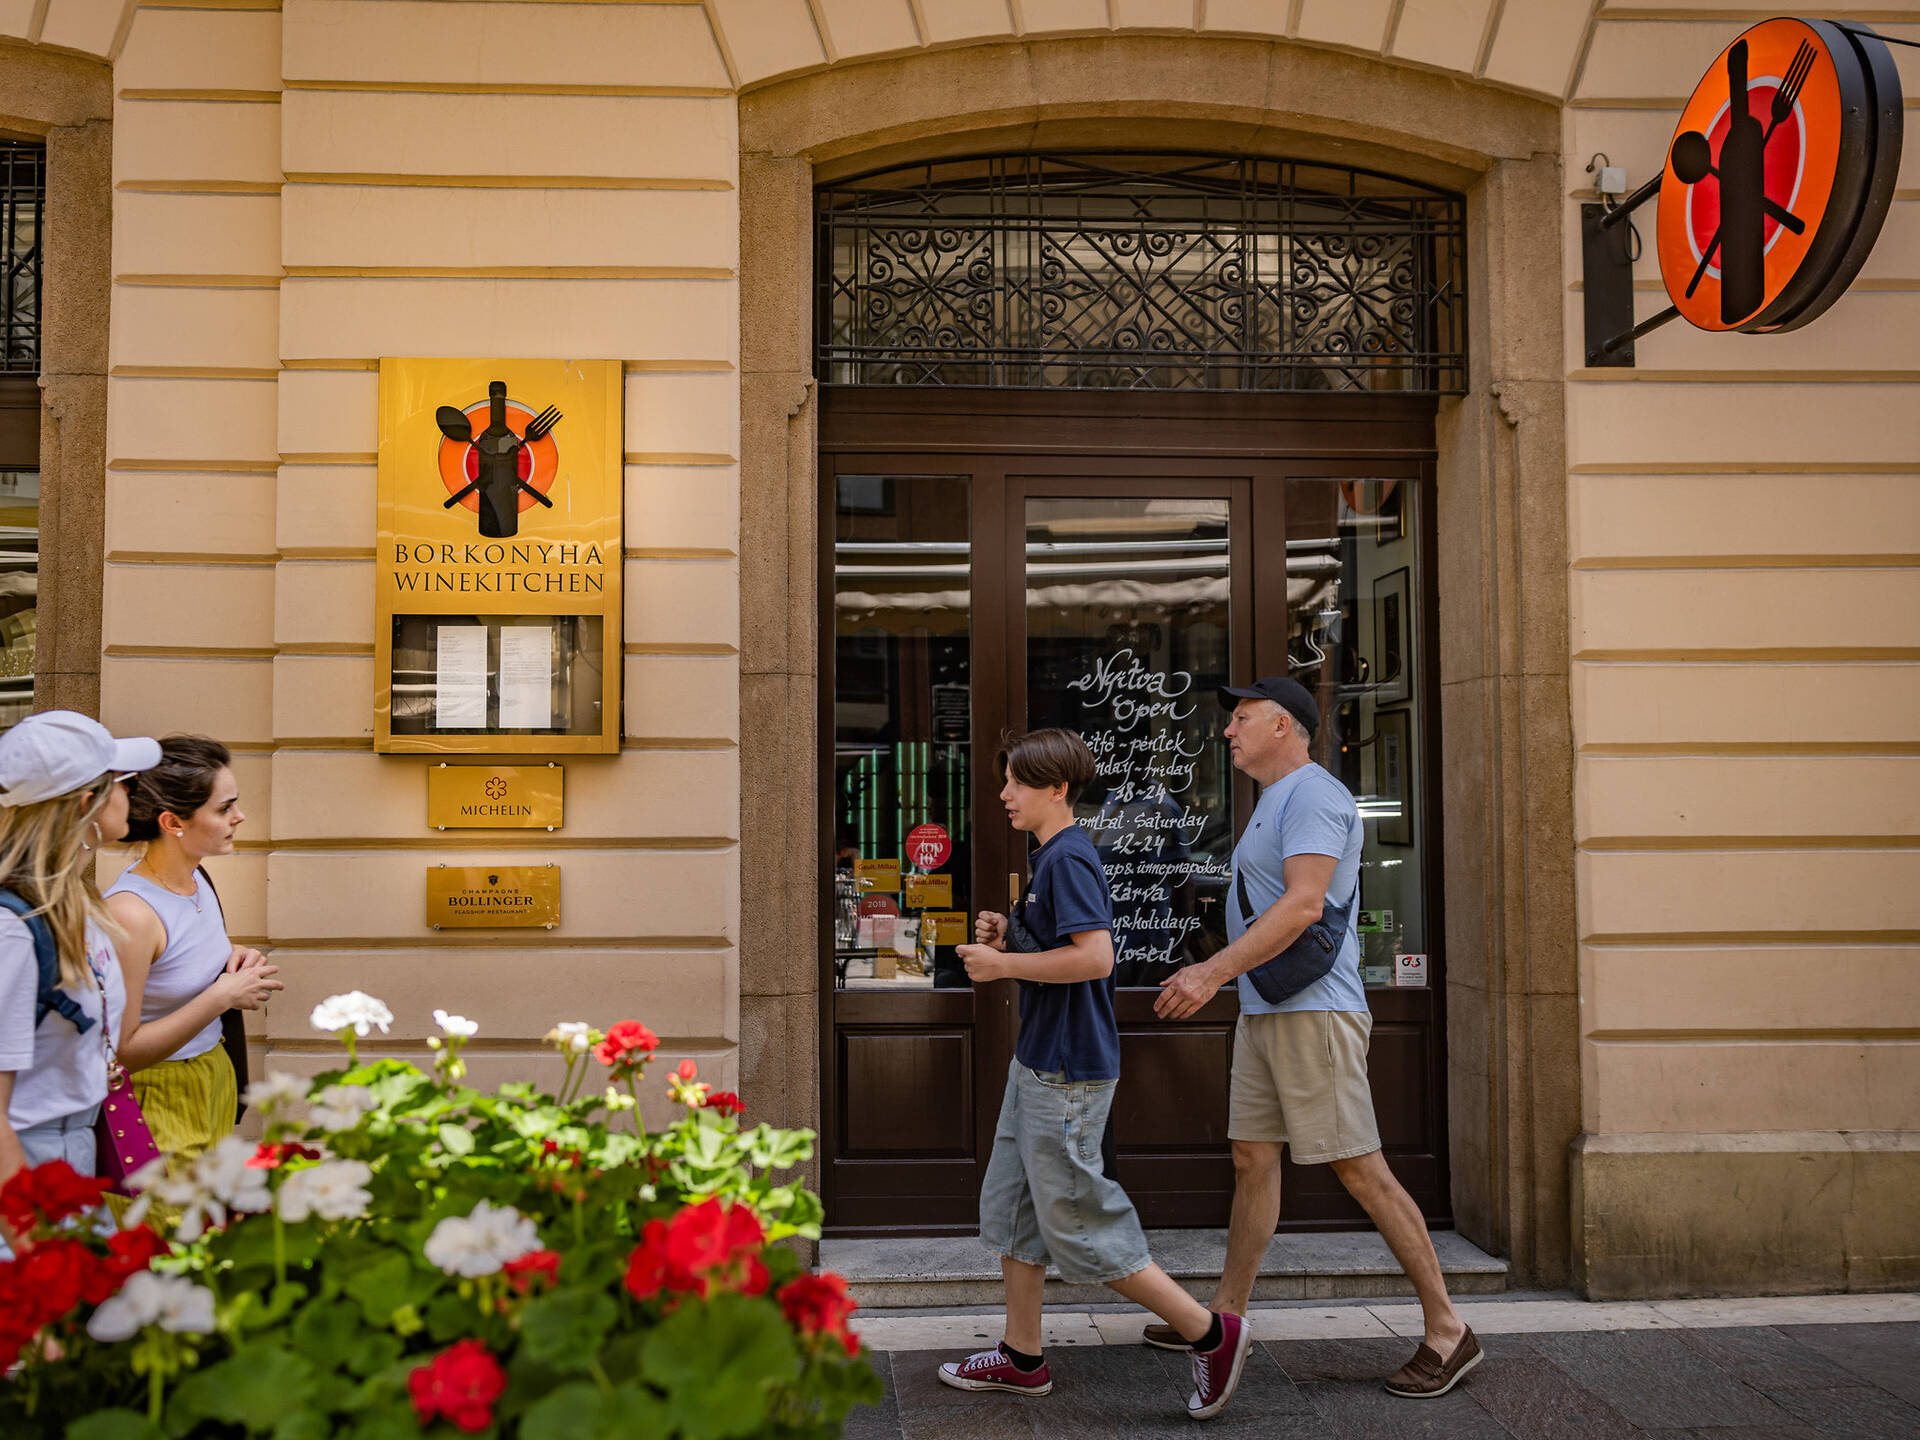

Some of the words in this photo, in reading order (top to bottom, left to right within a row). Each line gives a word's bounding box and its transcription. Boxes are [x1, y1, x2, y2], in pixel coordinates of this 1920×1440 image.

[395, 543, 604, 565] BORKONYHA
[394, 572, 604, 593] WINEKITCHEN
[1067, 648, 1192, 708] Nyitva
[1112, 694, 1197, 732] Open
[1122, 728, 1205, 762] péntek
[1096, 754, 1135, 791] nday
[1142, 754, 1196, 793] friday
[461, 805, 532, 816] MICHELIN
[448, 896, 535, 906] BOLLINGER
[1113, 935, 1184, 965] losed
